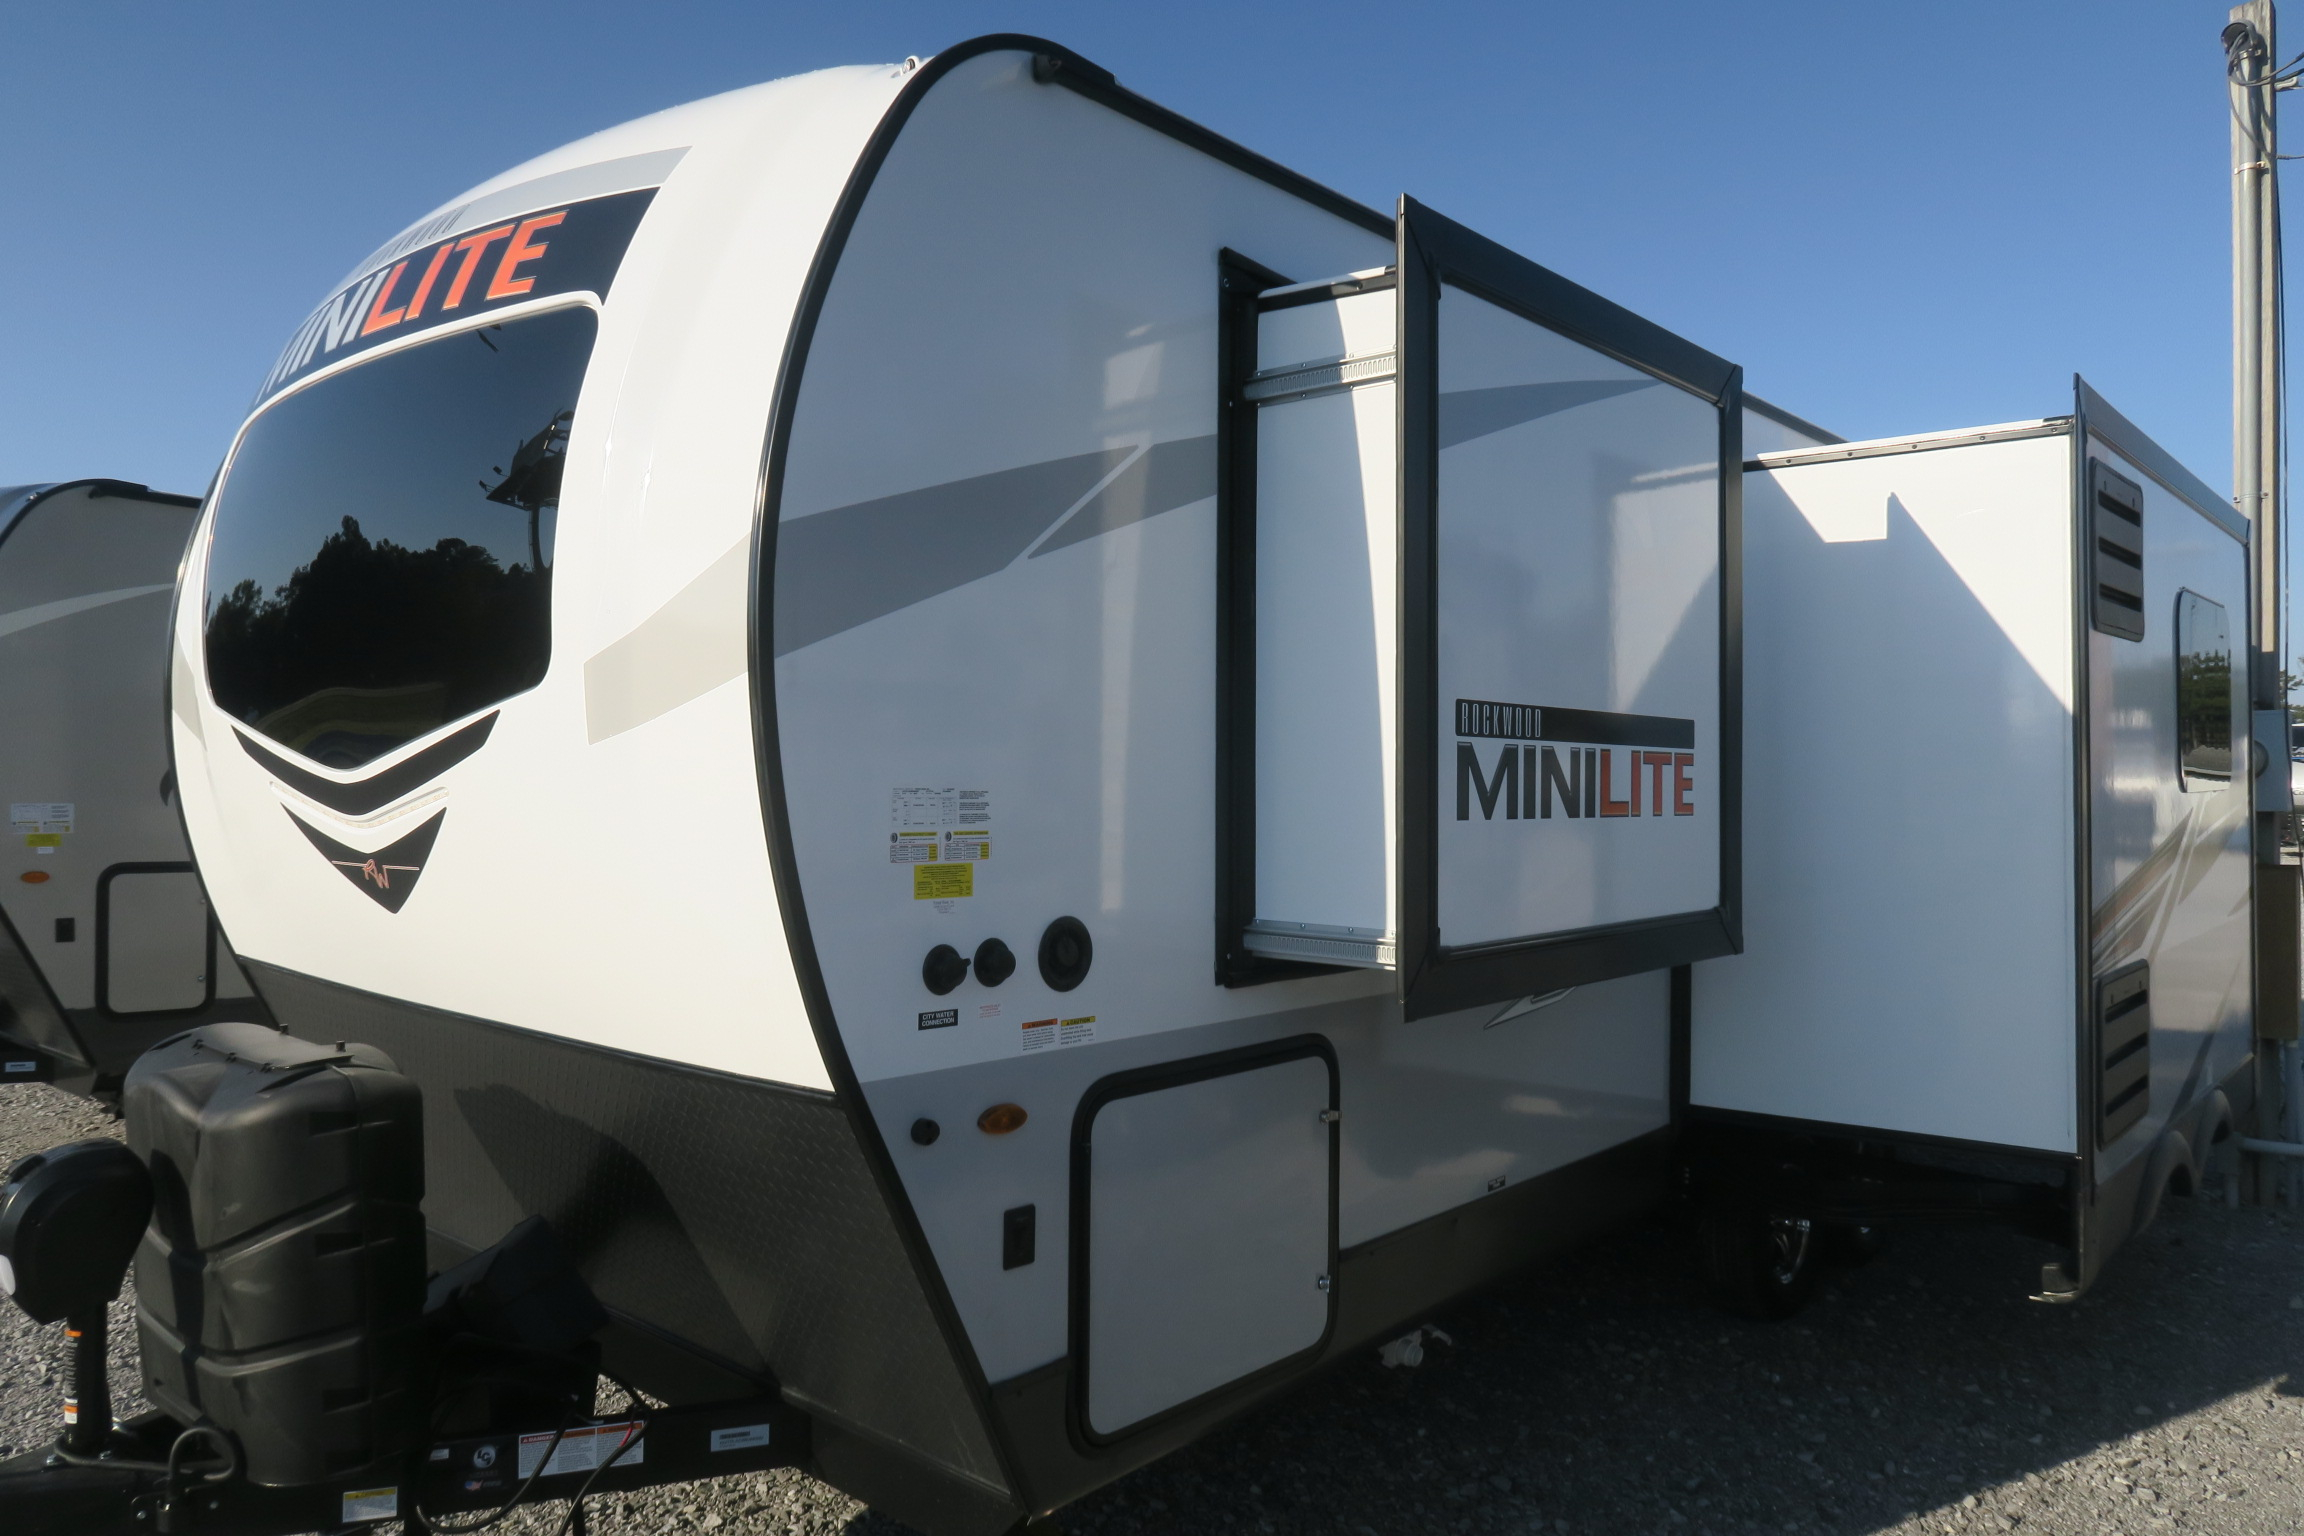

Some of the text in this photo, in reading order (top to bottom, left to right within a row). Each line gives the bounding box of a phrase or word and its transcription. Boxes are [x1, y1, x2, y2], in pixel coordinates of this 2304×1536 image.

[254, 209, 570, 405] MINILITE
[1461, 702, 1542, 738] ROCKWOOD
[1456, 741, 1695, 821] MINILITE
[921, 1017, 955, 1027] CONNECTION
[935, 1010, 955, 1018] WATER
